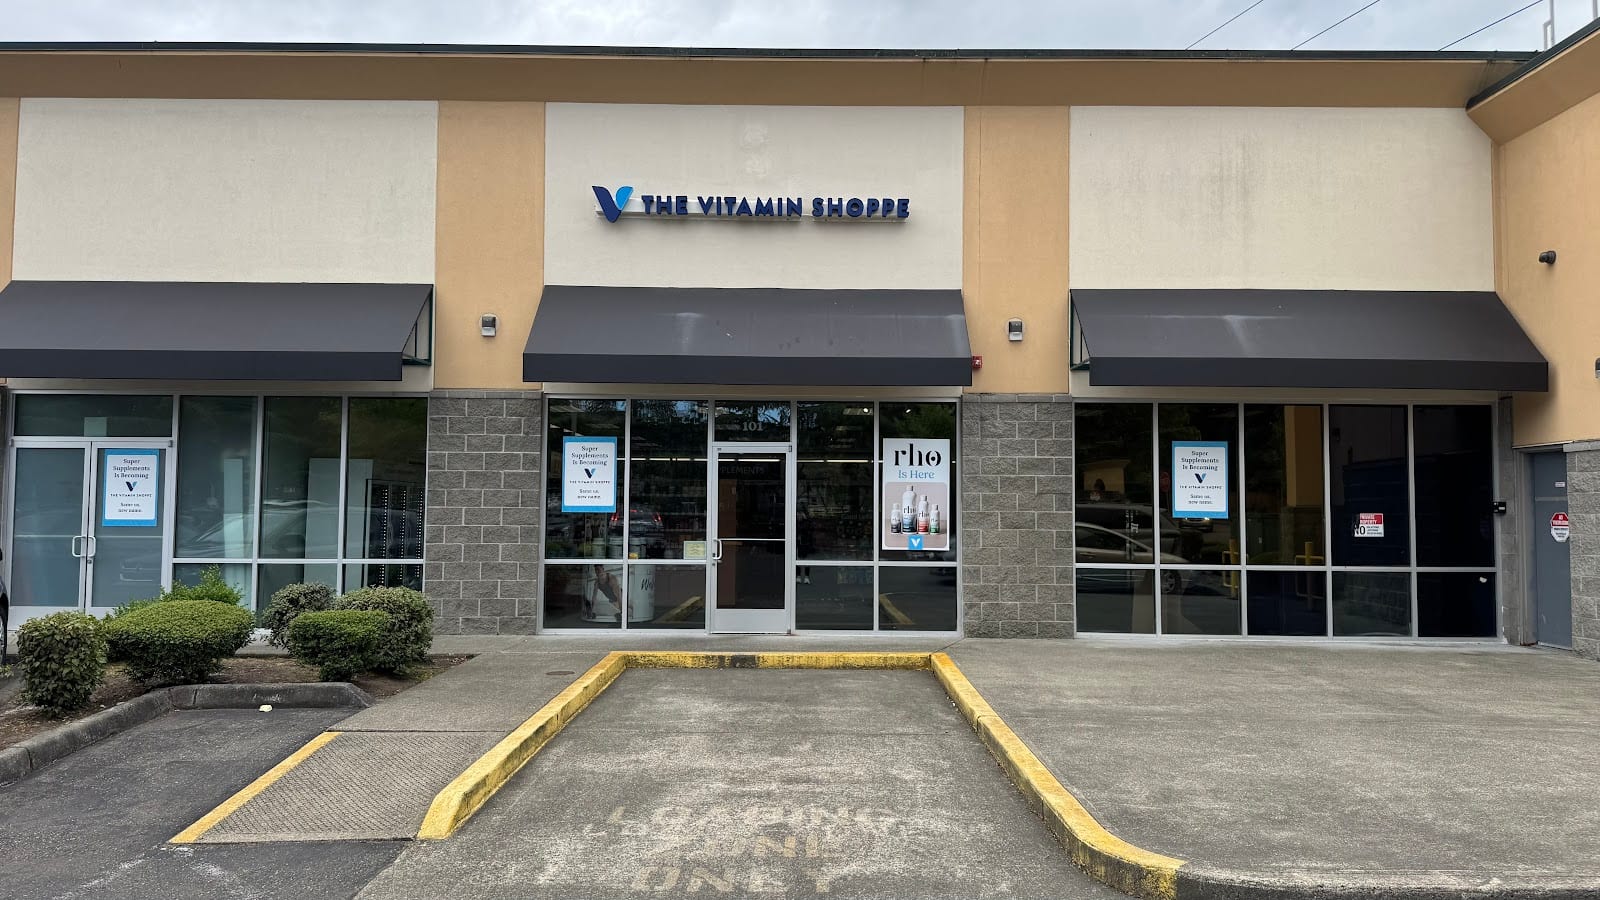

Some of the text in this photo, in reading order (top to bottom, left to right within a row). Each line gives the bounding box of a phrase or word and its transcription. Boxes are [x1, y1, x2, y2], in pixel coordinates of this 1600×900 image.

[641, 195, 910, 218] THE VITAMIN SHOPPE
[742, 421, 764, 432] 101
[894, 443, 942, 467] rho
[898, 469, 935, 479] Is Here
